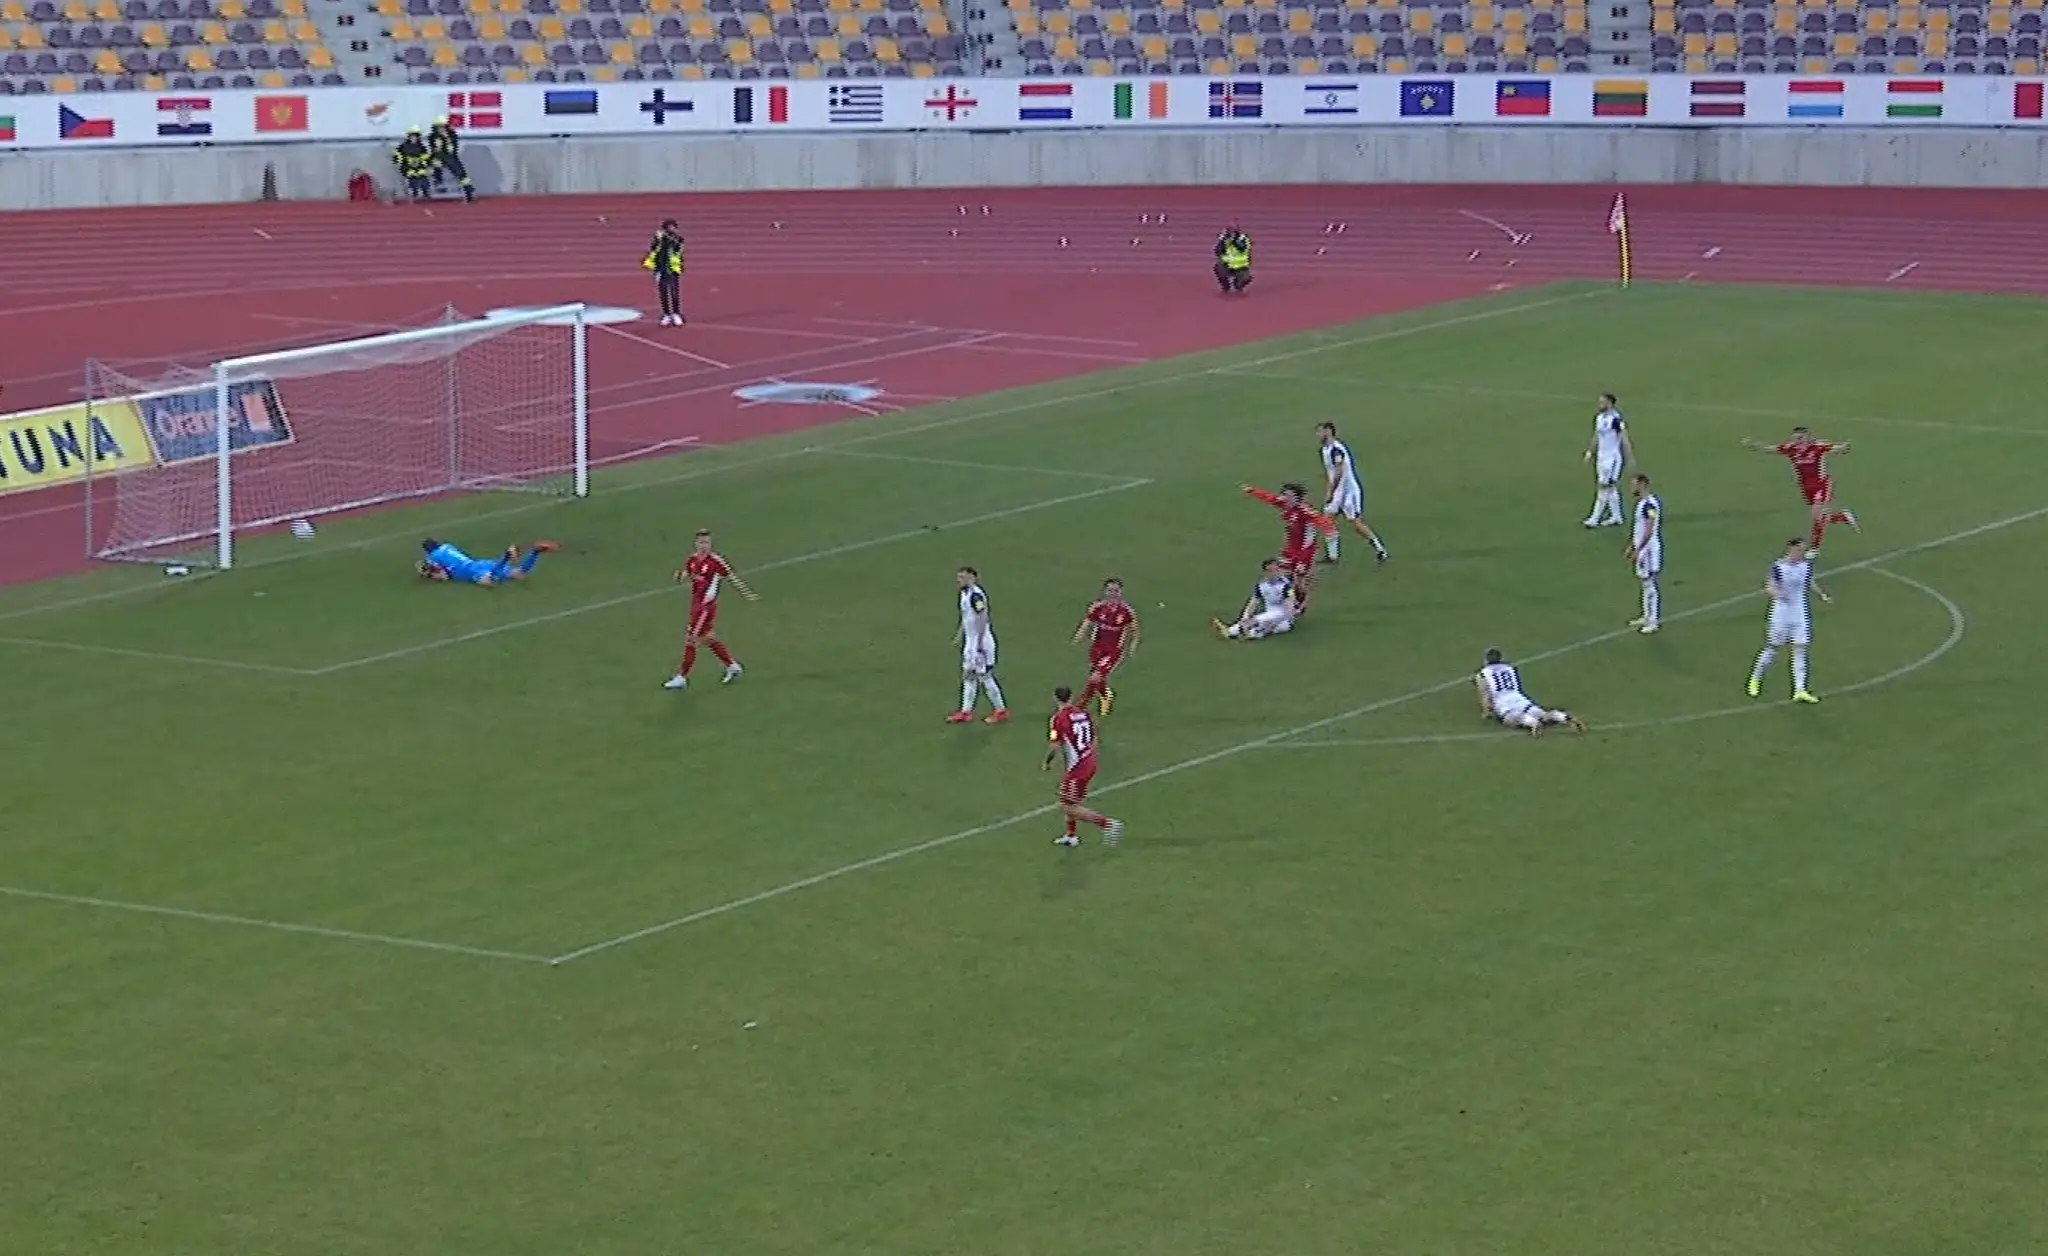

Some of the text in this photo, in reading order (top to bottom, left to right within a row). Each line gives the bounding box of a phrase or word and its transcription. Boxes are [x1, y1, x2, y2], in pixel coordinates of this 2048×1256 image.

[155, 406, 241, 440] Orane
[0, 416, 125, 479] UNA
[1492, 670, 1515, 692] 18
